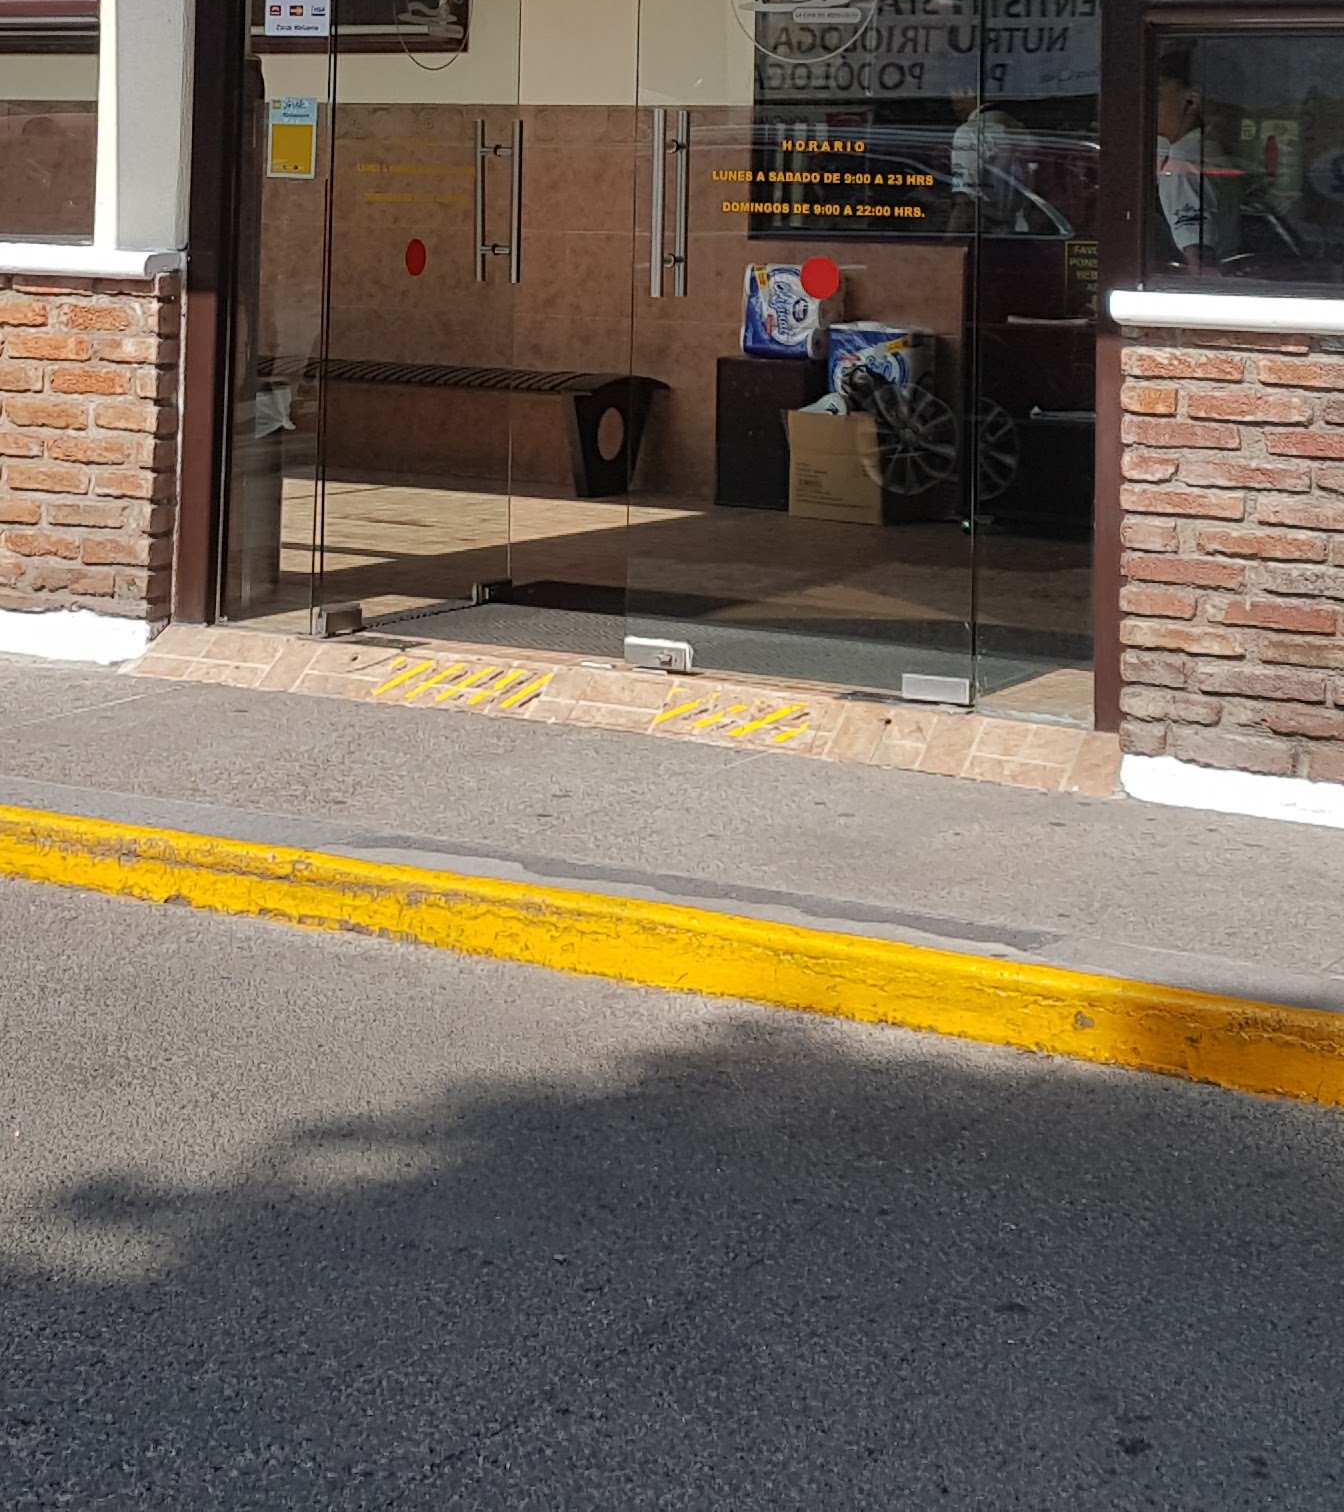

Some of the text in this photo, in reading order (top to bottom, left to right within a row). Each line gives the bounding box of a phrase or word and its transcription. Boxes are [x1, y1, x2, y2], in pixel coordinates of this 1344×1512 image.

[781, 140, 866, 153] HORARIO
[712, 170, 934, 186] LUNES A SABADO DE 9:00 A 23 HRS
[722, 201, 926, 218] DOMINGOS DE 9:00 A 22:00 HRS.
